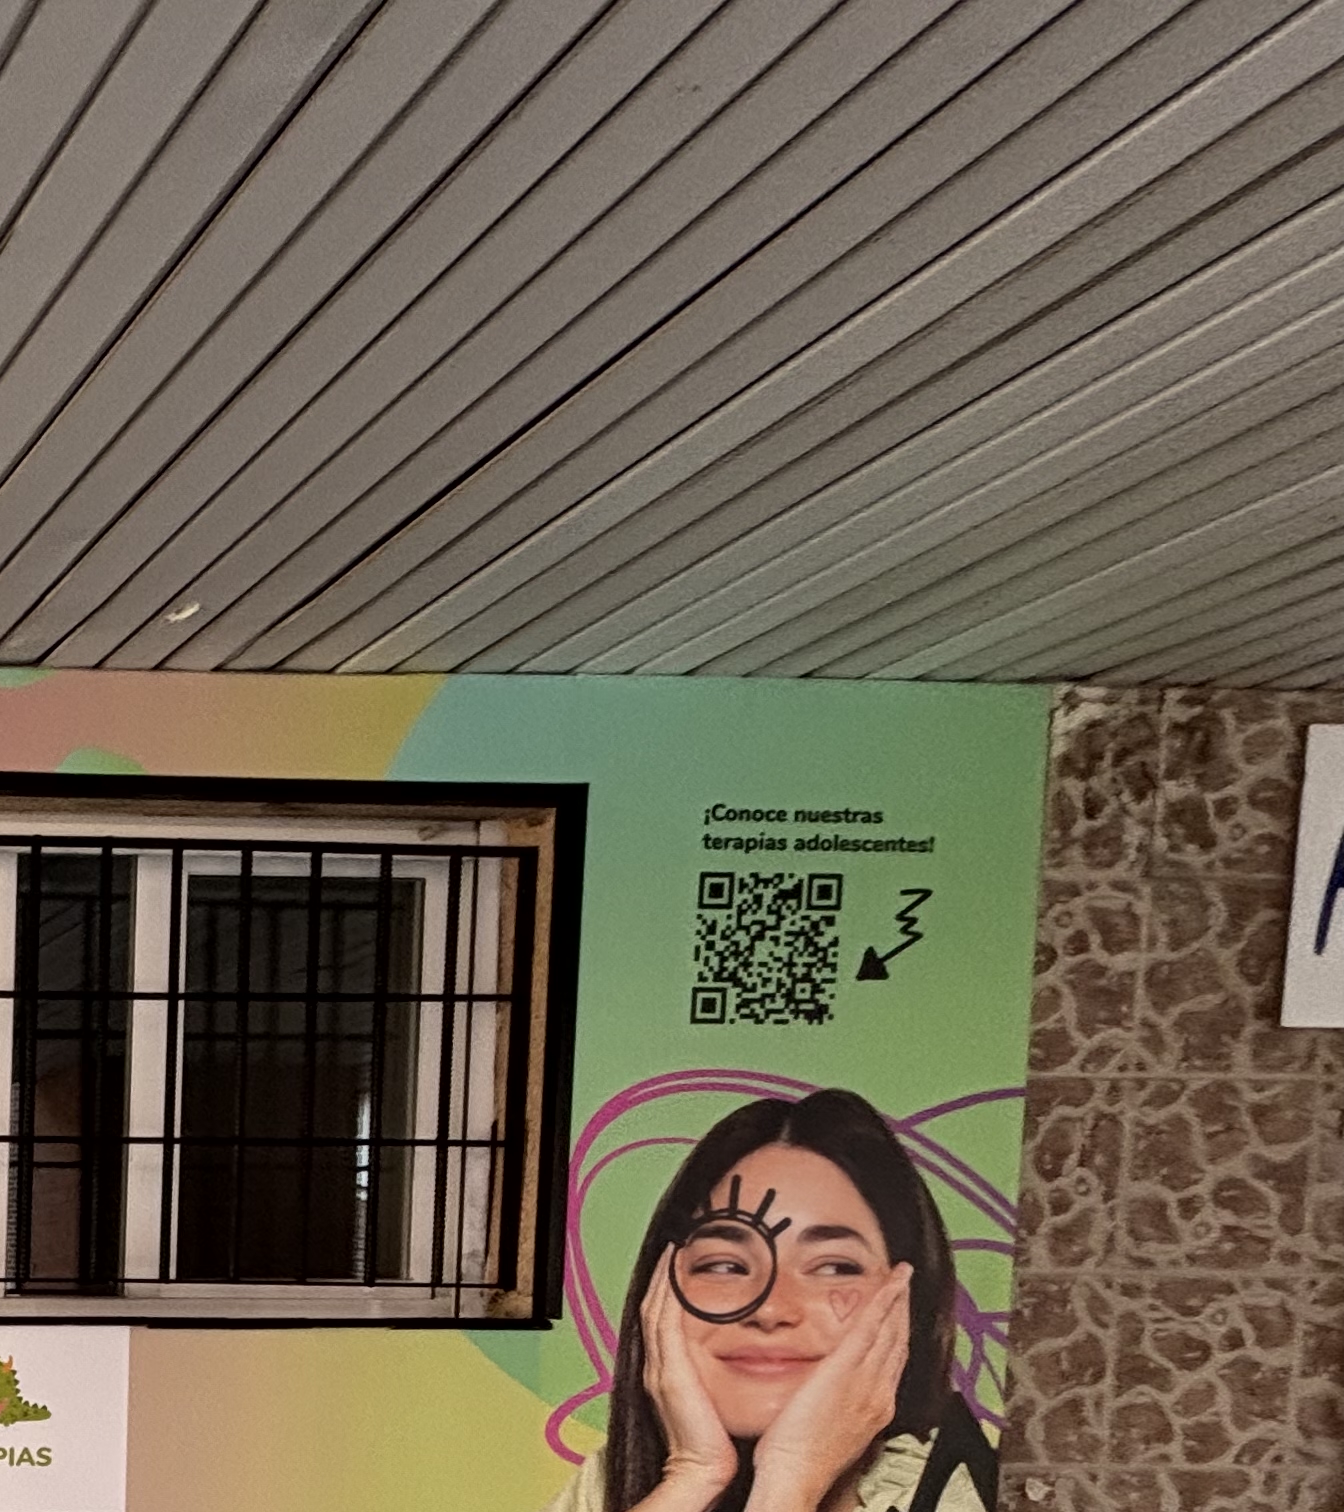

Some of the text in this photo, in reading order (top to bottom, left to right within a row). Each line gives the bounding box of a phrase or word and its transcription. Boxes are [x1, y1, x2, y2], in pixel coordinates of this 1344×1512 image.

[704, 803, 884, 826] ¡Conoce nuestras
[702, 832, 935, 853] terapias adolescentes!
